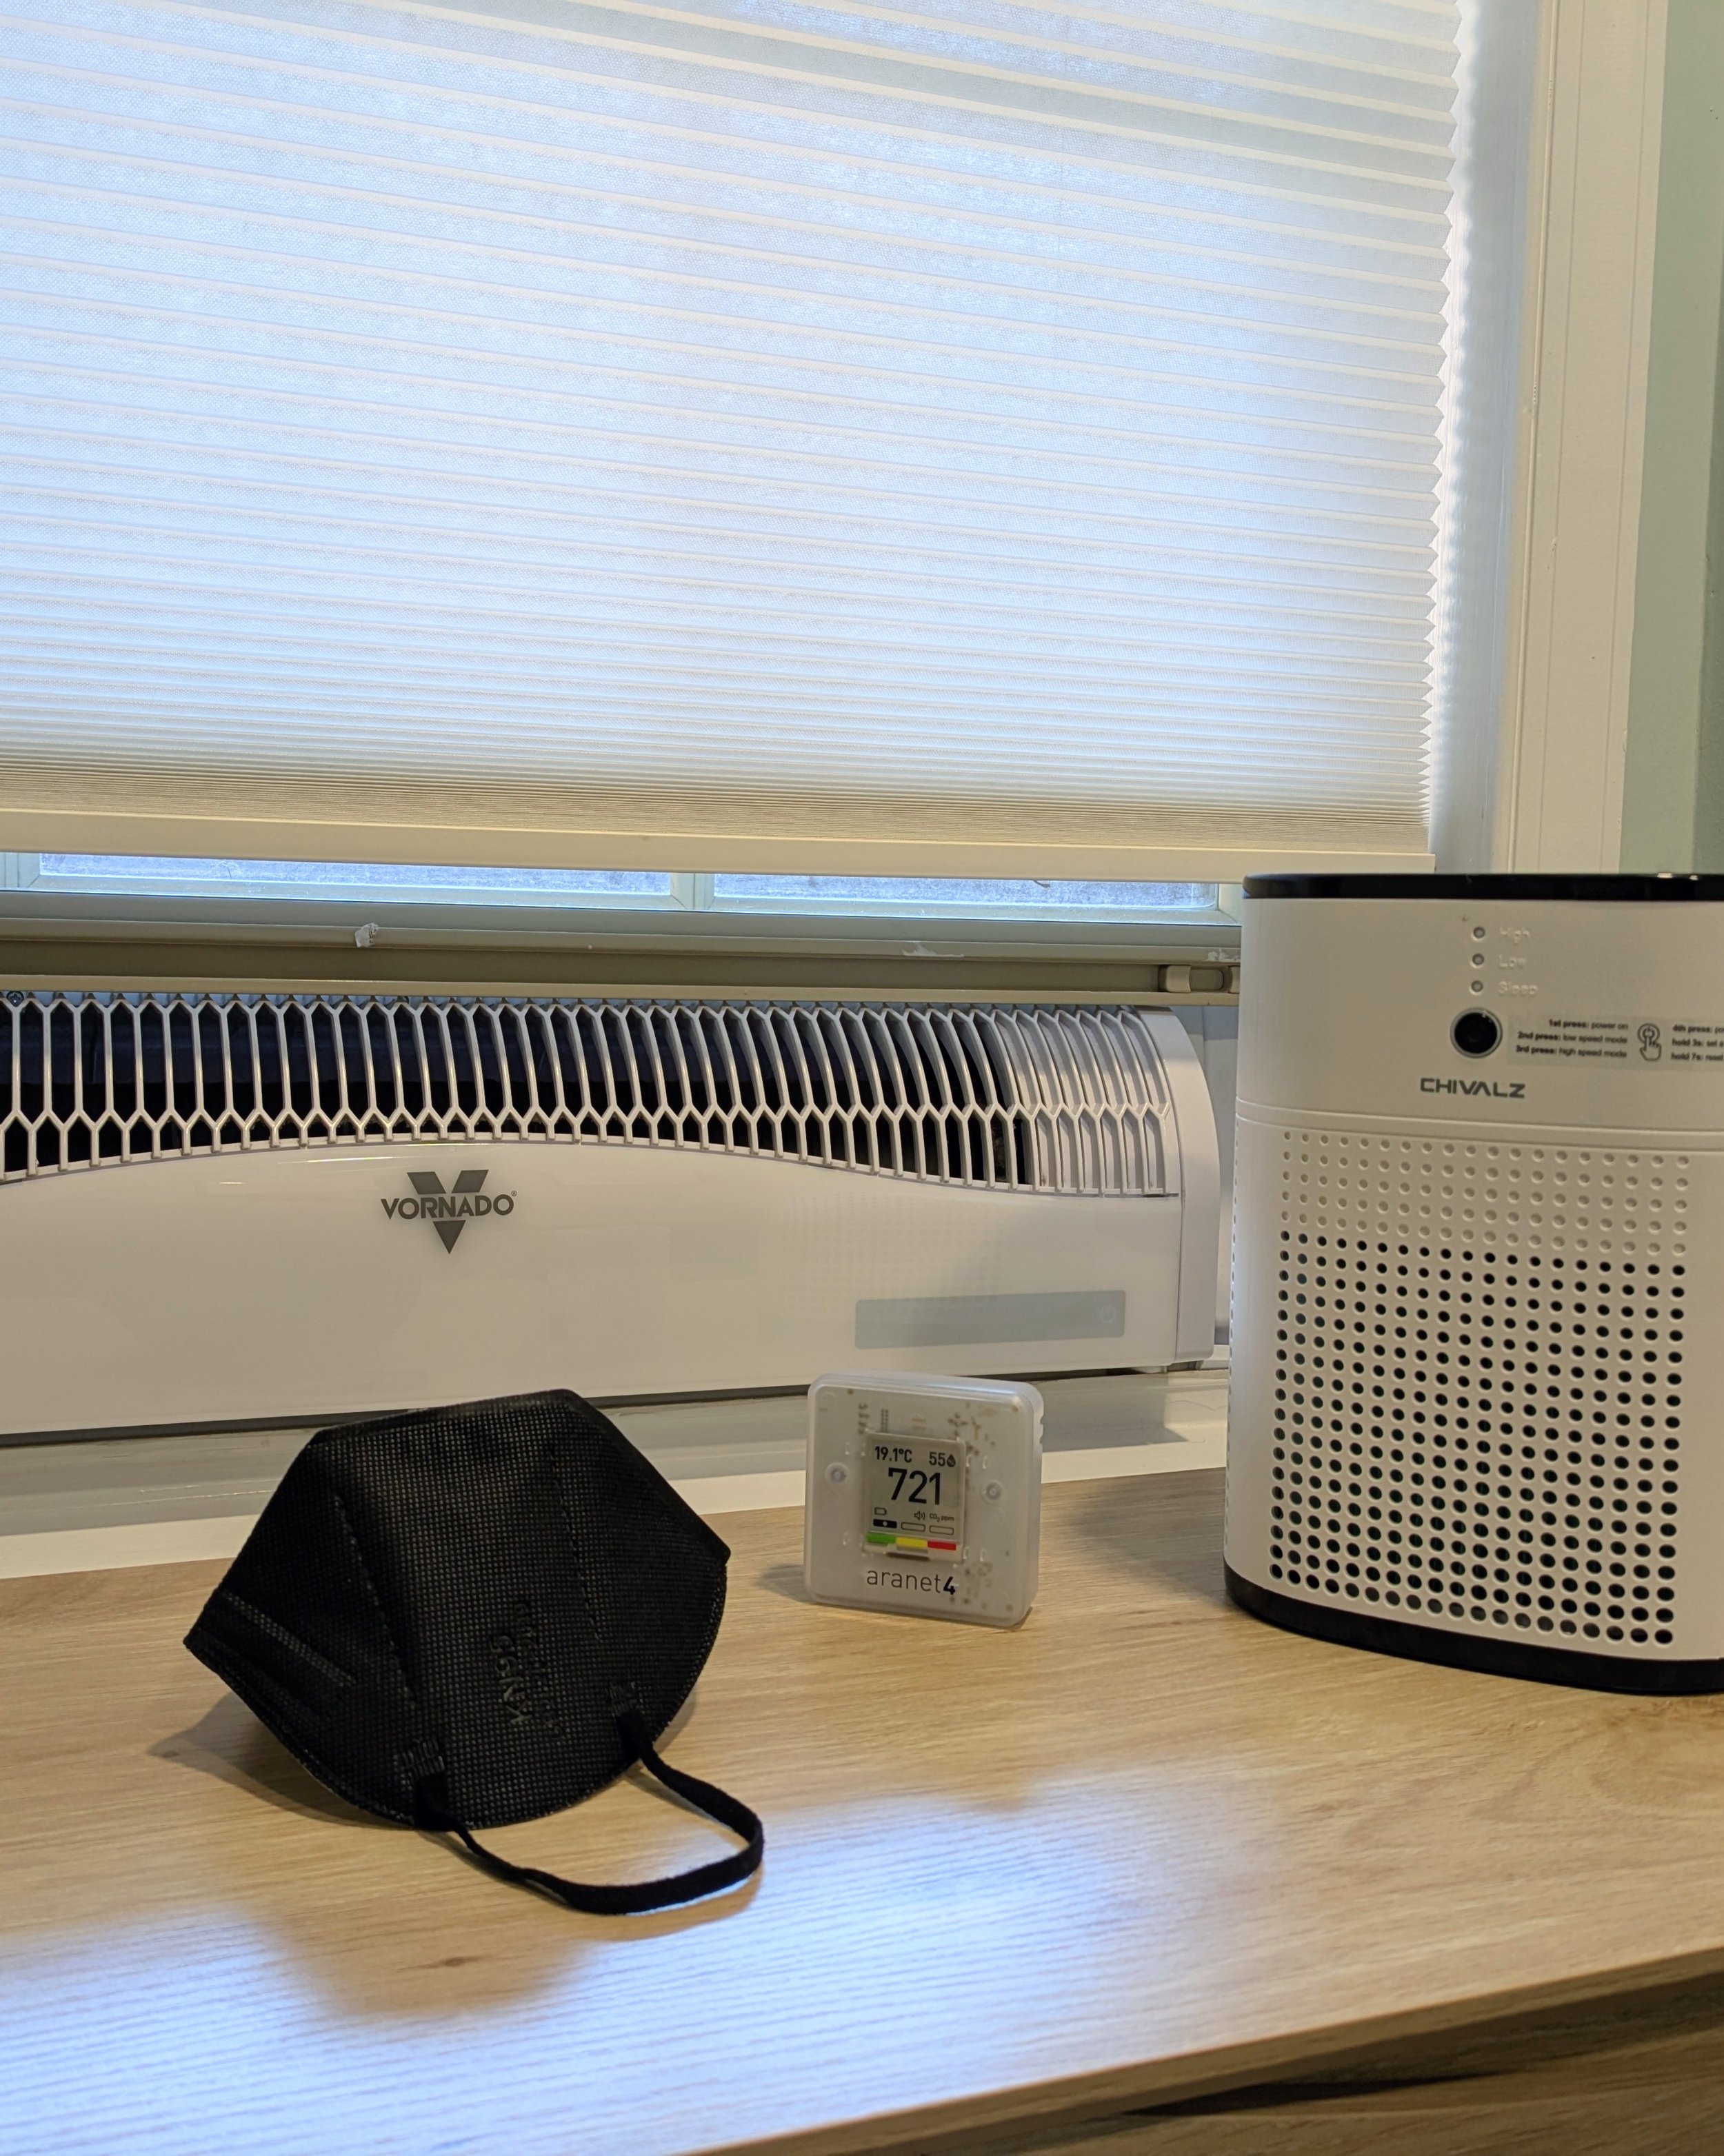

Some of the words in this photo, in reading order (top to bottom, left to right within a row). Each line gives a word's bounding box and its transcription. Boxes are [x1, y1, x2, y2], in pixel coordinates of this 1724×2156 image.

[1499, 954, 1527, 969] Low
[1497, 980, 1538, 997] Sleep
[1518, 1031, 1533, 1039] 2nd
[1516, 1045, 1529, 1053] 3rd
[1421, 1078, 1525, 1098] CHIVALZ
[380, 1193, 515, 1220] VORNADO
[874, 1446, 912, 1463] 19.1°C
[888, 1467, 941, 1505] 721
[866, 1570, 956, 1595] aranet4
